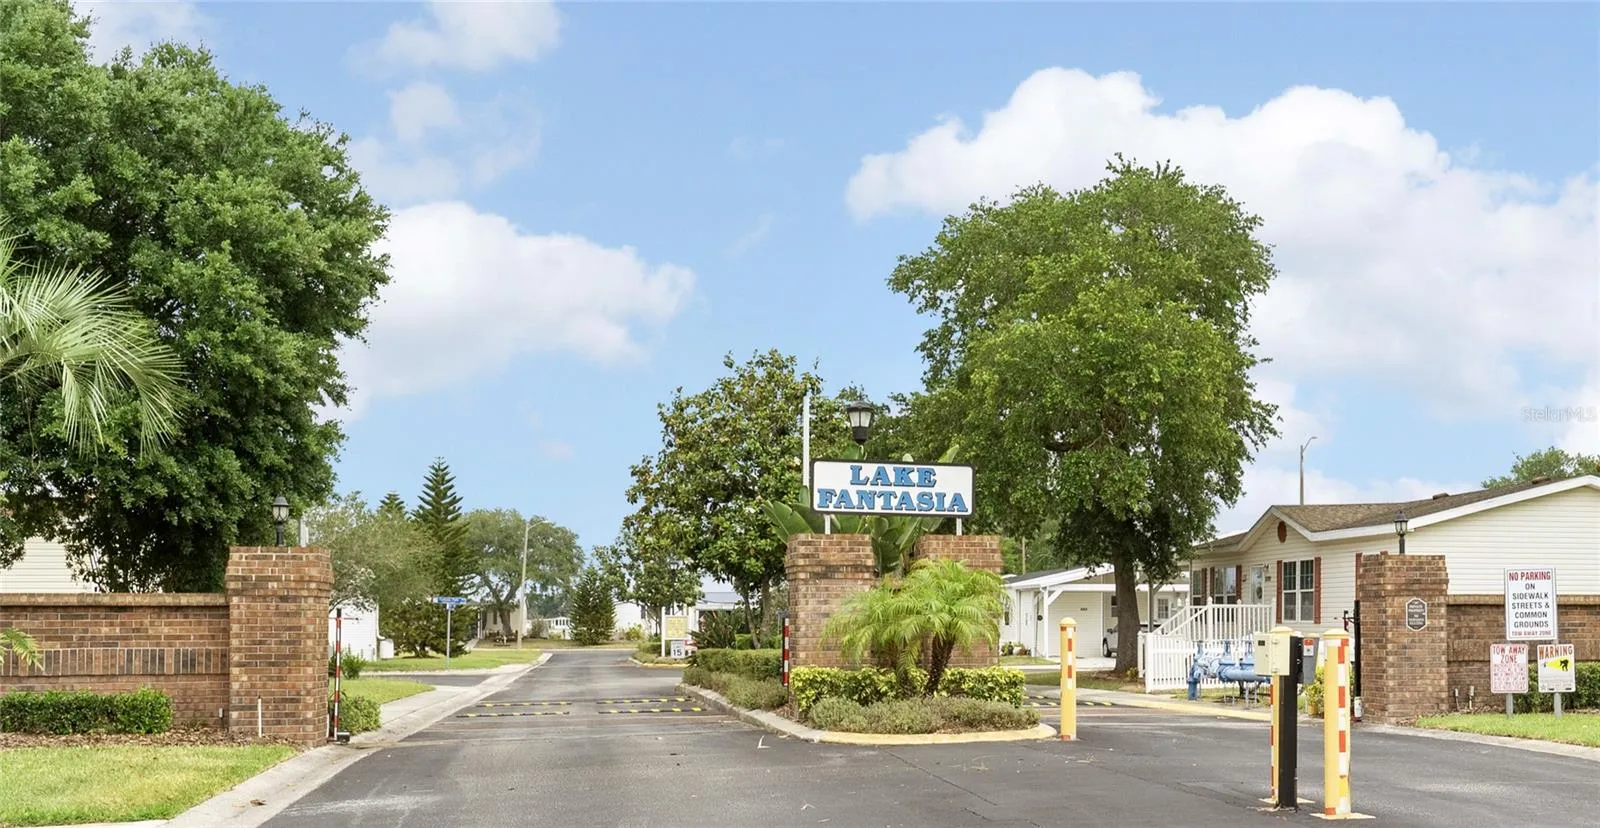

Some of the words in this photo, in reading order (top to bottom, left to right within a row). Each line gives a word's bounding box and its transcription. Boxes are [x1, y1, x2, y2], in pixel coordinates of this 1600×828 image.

[850, 465, 936, 488] LAKE
[817, 488, 968, 513] FANTASIA
[1509, 572, 1519, 581] NO
[1520, 571, 1551, 581] PARKING
[1512, 592, 1549, 600] SIDEWALK
[1511, 602, 1543, 610] STREETS
[1514, 611, 1548, 619] COMMON
[1513, 620, 1549, 628] GROUNDS
[1493, 646, 1506, 655] TOW
[1508, 646, 1525, 655] AWAY
[1539, 646, 1573, 660] WARNING
[1500, 655, 1518, 664] ZONE
